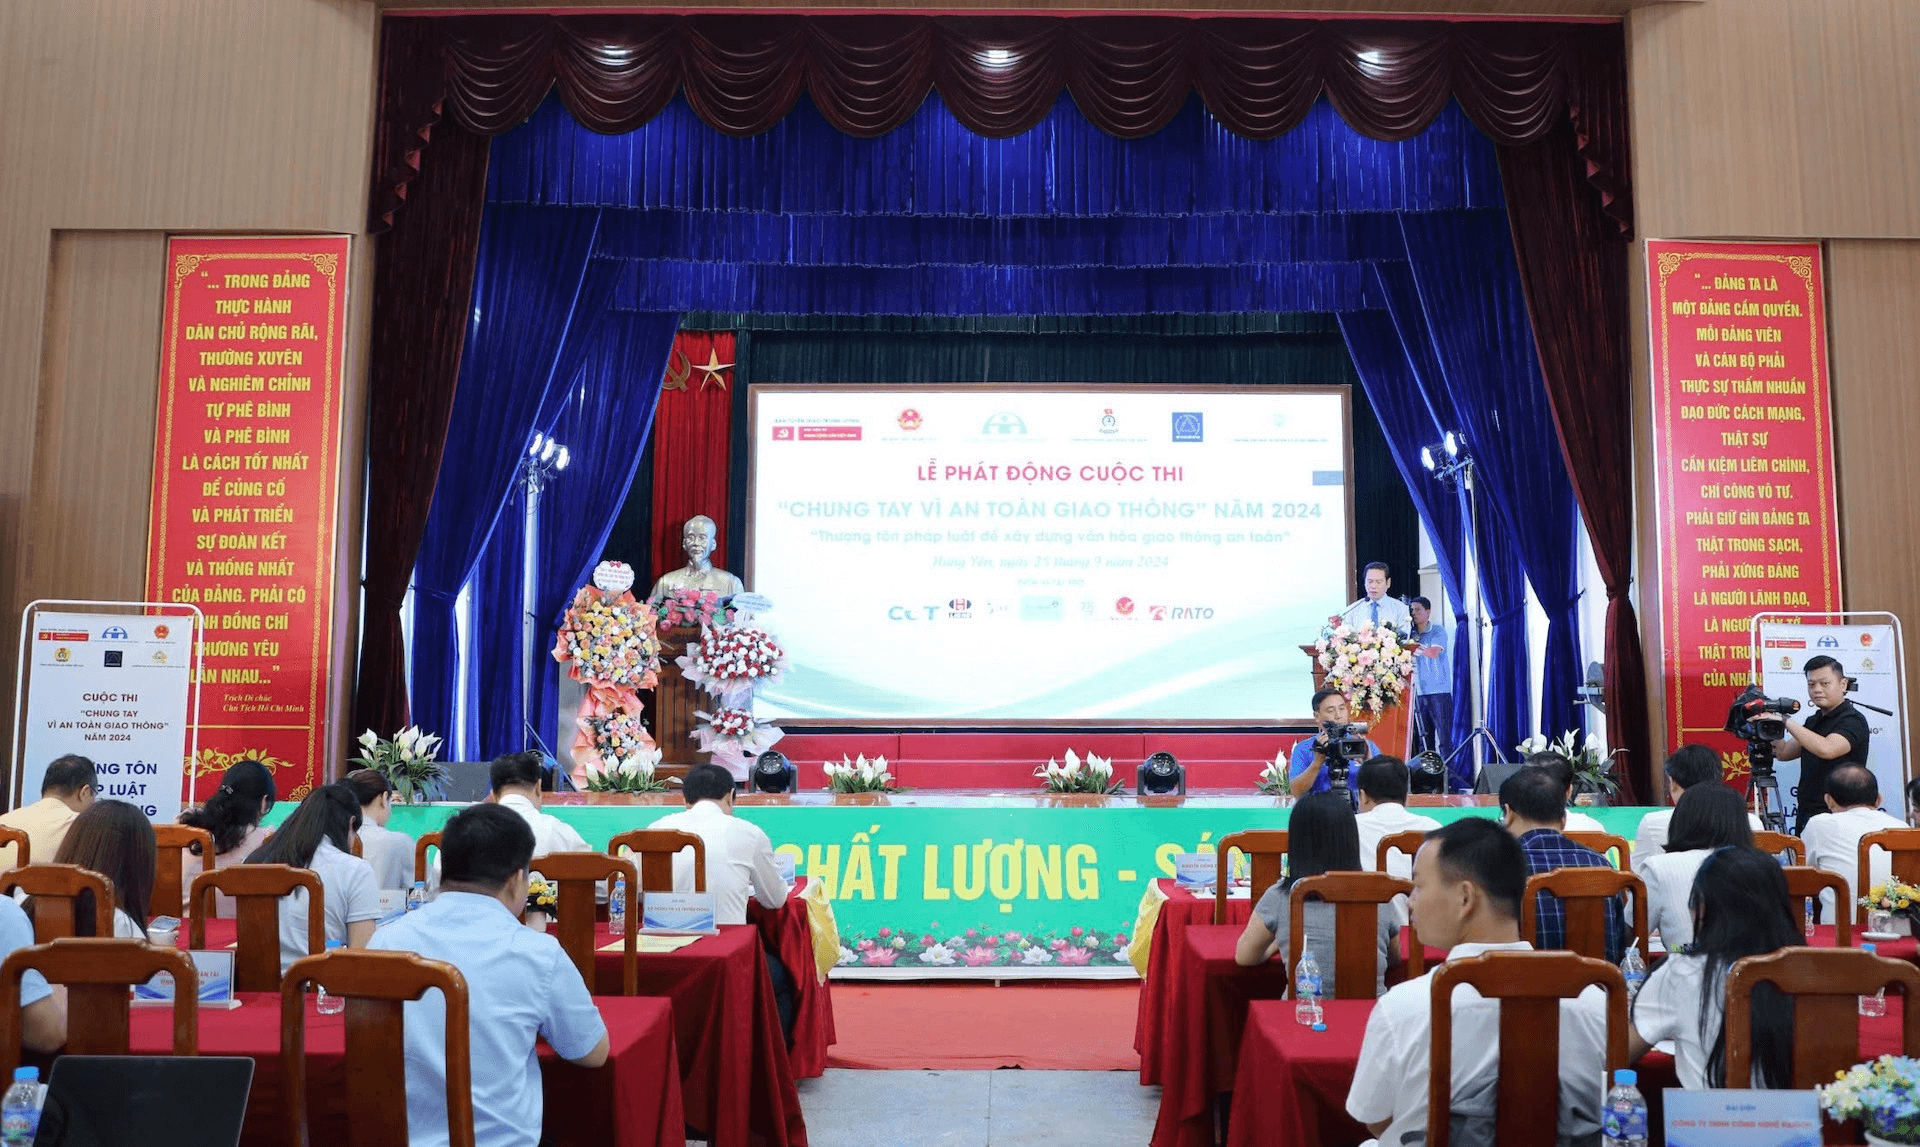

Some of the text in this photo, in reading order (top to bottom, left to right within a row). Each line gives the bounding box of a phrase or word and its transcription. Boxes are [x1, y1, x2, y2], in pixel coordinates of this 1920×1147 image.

[224, 270, 310, 288] TRONG ĐẢNG
[1715, 273, 1778, 291] ĐẢNG TA LÀ
[216, 297, 291, 316] THỰC HÀNH
[1673, 300, 1696, 318] MỘT
[1699, 298, 1730, 315] ĐẢNG
[186, 321, 318, 342] DÂN CHỦ RỘNG RÃI,
[1696, 324, 1781, 342] MỖI ĐẢNG VIÊN
[200, 348, 302, 365] THƯỜNG XUYÊN
[1695, 351, 1785, 370] VÀ CÁN BỘ PHẢI
[188, 373, 310, 391] VÀ NGHIÊM CHỈNH
[1680, 379, 1709, 395] THỰC
[1713, 379, 1729, 396] SỰ
[206, 401, 290, 420] TỰ PHÊ BÌNH
[1681, 404, 1805, 422] ĐẠO ĐỨC CÁCH MẠNG,
[204, 427, 290, 443] VÀ PHÊ BÌNH
[1721, 429, 1768, 448] THẬT SỰ
[182, 450, 309, 470] LÀ CÁCH TỐT NHẤT
[1708, 456, 1737, 475] KIỆM
[1741, 456, 1768, 472] LIÊM
[1771, 456, 1810, 474] CHÍNH,
[917, 458, 1183, 485] LỄ PHÁT ĐỘNG CUỘC THI
[203, 477, 285, 496] ĐỂ CỦNG CỐ
[1701, 482, 1793, 499] CHÍ CÔNG VÔ TƯ.
[192, 503, 293, 522] VÀ PHÁT TRIỂN
[777, 497, 1322, 519] “CHUNG TAY VÌ AN TOÀN GIAO THÔNG” NĂM 2024
[1686, 507, 1810, 525] PHẢI GIỮ GÌN ĐẢNG TA
[197, 530, 287, 552] SỰ ĐOÀN KẾT
[876, 530, 899, 542] tôn
[904, 530, 942, 545] pháp
[947, 530, 975, 543] luật
[1004, 530, 1030, 545] xây
[1142, 531, 1175, 546] giao
[1180, 530, 1221, 545] thông
[1227, 533, 1245, 543] an
[1695, 535, 1803, 555] THẬT TRONG SẠCH,
[186, 557, 295, 576] VÀ THỐNG NHẤT
[1702, 560, 1799, 578] PHẢI XỨNG ĐÁNG
[172, 584, 306, 603] CỦA ĐẢNG. PHẢI CÓ
[1693, 589, 1810, 608] LÀ NGƯỜI LÃNH ĐẠO,
[265, 612, 288, 629] CHÍ
[1171, 607, 1214, 620] RATO
[1704, 616, 1719, 632] LÀ
[253, 639, 279, 656] YÊU
[1698, 643, 1726, 662] THẬT
[1703, 668, 1727, 686] CỦA
[82, 691, 138, 704] CUỘC THI
[47, 720, 56, 729] VÌ
[76, 720, 101, 729] TOÀN
[84, 732, 131, 741] NĂM 2024
[125, 760, 157, 774] TÔN
[110, 781, 147, 799] LUẬT
[922, 838, 1099, 913] LƯỢNG
